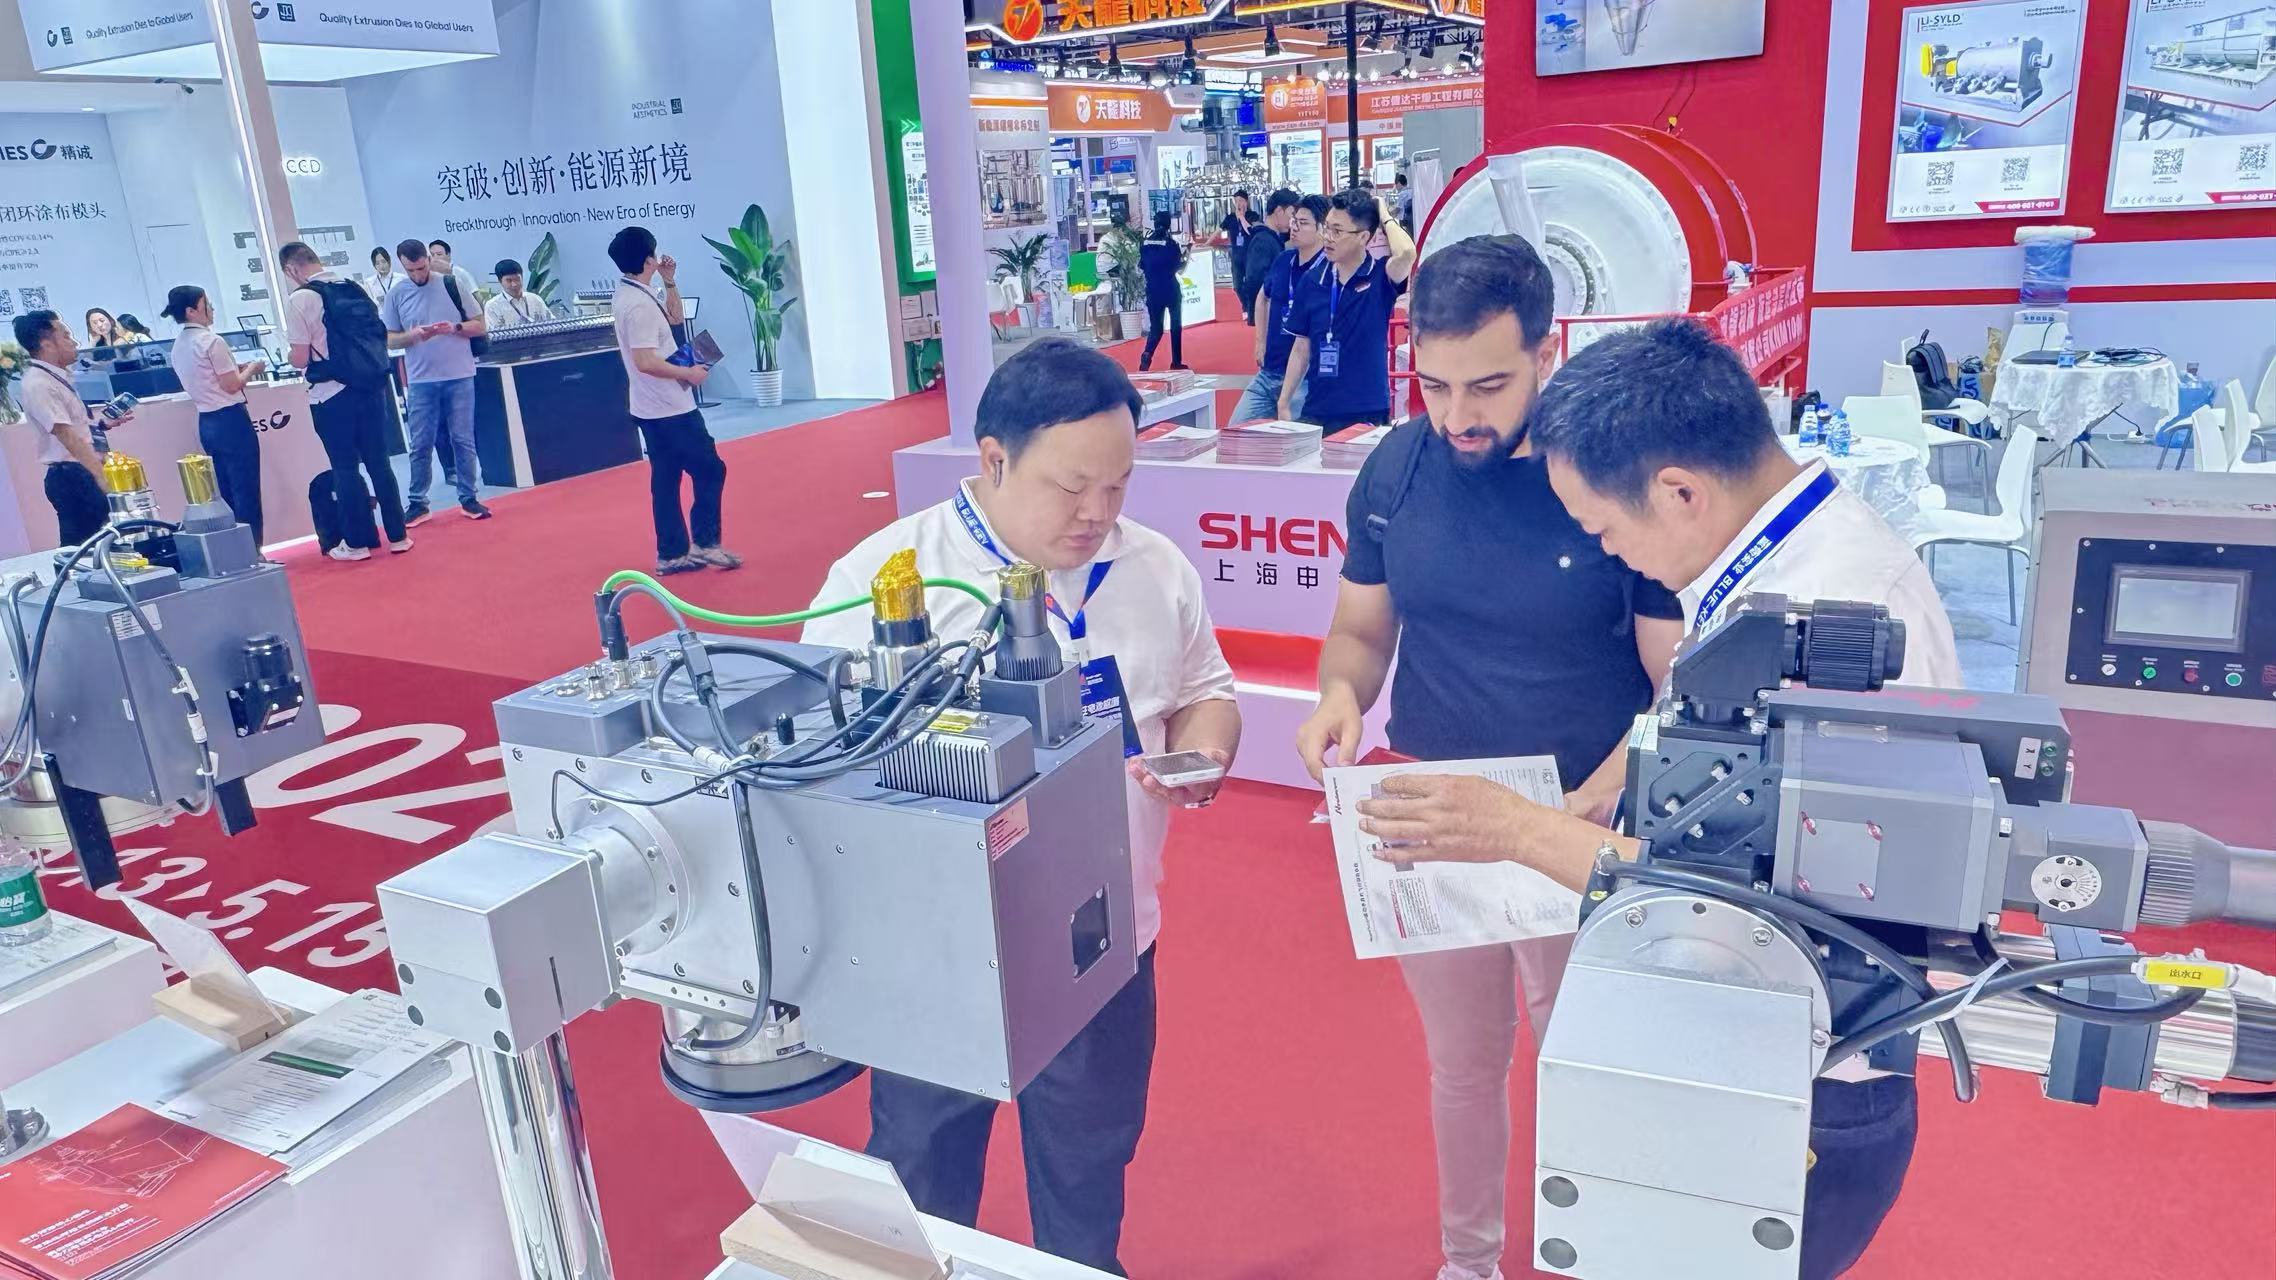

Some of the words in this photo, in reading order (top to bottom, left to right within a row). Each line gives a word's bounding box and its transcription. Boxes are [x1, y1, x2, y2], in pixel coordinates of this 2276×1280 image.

[86, 27, 108, 40] Quality
[155, 14, 176, 27] Global
[176, 12, 194, 24] Users
[318, 12, 353, 26] Quality
[353, 15, 395, 28] Extrusion
[394, 18, 413, 29] Dies
[414, 19, 424, 30] to
[424, 20, 451, 32] Global
[451, 22, 475, 33] Users
[60, 144, 93, 161] 精诚
[445, 215, 517, 233] Breakthrough
[522, 210, 581, 227] Innovation
[587, 206, 615, 222] New
[616, 205, 637, 220] Era
[637, 203, 651, 218] of
[653, 202, 696, 220] Energy
[1198, 512, 1347, 558] SHEN
[1213, 558, 1342, 590] 上海申
[2168, 968, 2202, 981] 出水口
